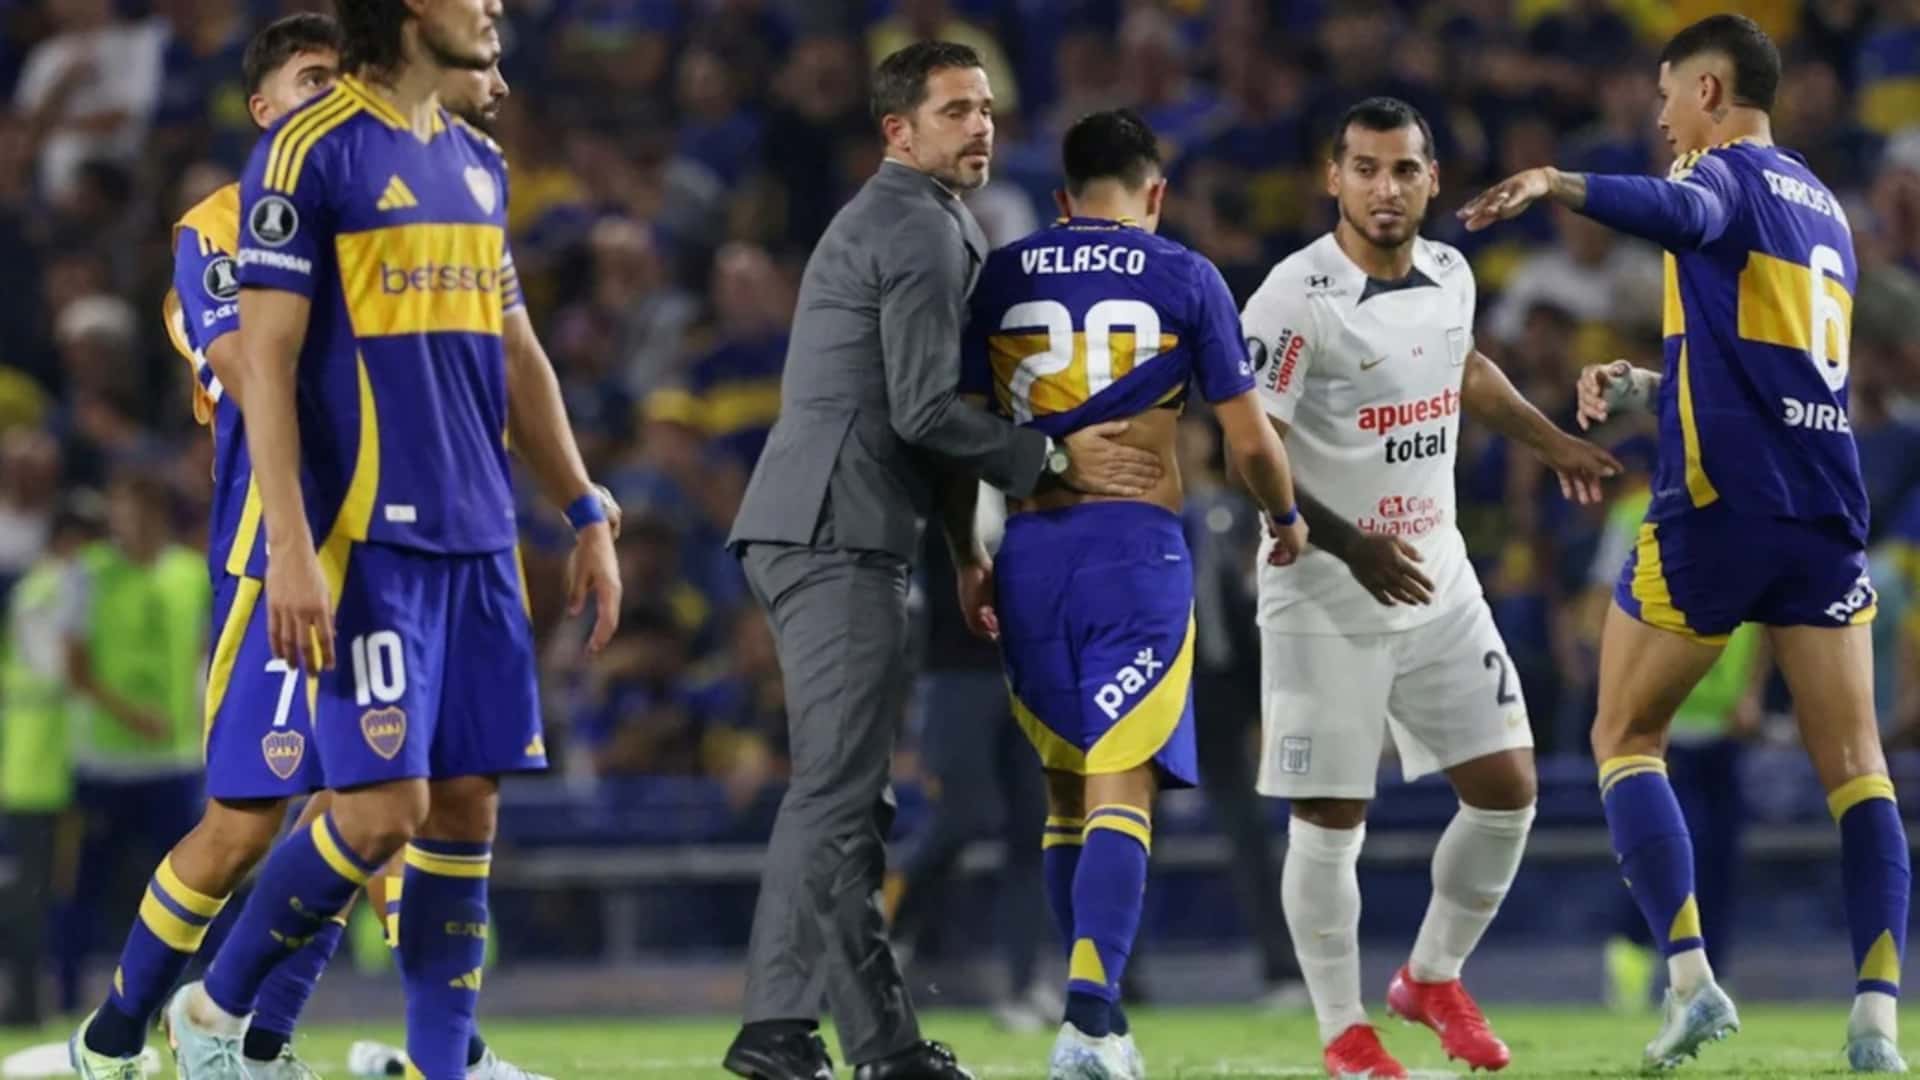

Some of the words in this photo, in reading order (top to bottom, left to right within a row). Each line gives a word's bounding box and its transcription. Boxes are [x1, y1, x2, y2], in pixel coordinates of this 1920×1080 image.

[381, 260, 502, 295] betsso
[1021, 244, 1145, 275] VELASCO
[1810, 244, 1850, 392] 6
[1001, 300, 1161, 426] 20
[1385, 426, 1446, 464] total
[265, 658, 299, 727] 7
[352, 630, 406, 706] 10
[1094, 647, 1163, 720] pax
[1484, 650, 1517, 706] 2
